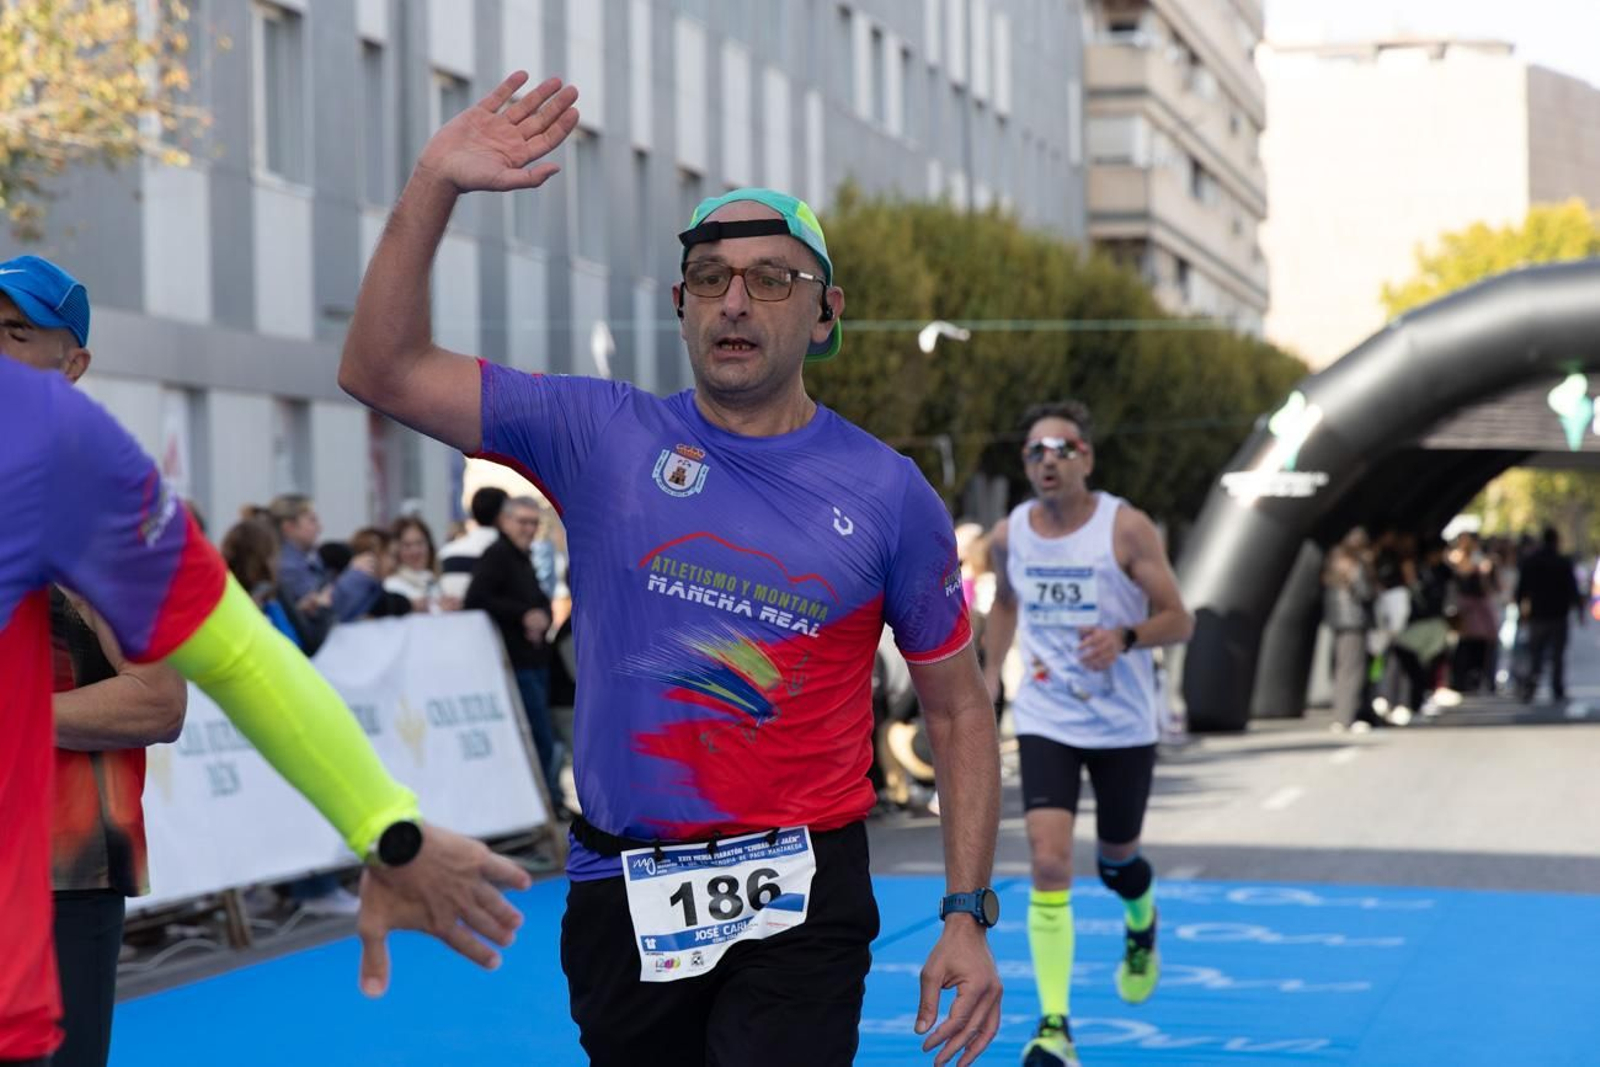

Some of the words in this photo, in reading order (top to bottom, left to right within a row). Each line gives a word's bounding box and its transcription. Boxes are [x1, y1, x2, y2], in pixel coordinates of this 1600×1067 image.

[648, 574, 753, 618] MANCHA
[759, 605, 820, 638] REAL
[651, 555, 736, 592] ATLETISMO
[742, 580, 751, 594] Y
[753, 584, 828, 622] MONTAÑA
[1035, 583, 1082, 604] 763
[669, 867, 782, 928] 186
[694, 923, 720, 942] JOSÉ
